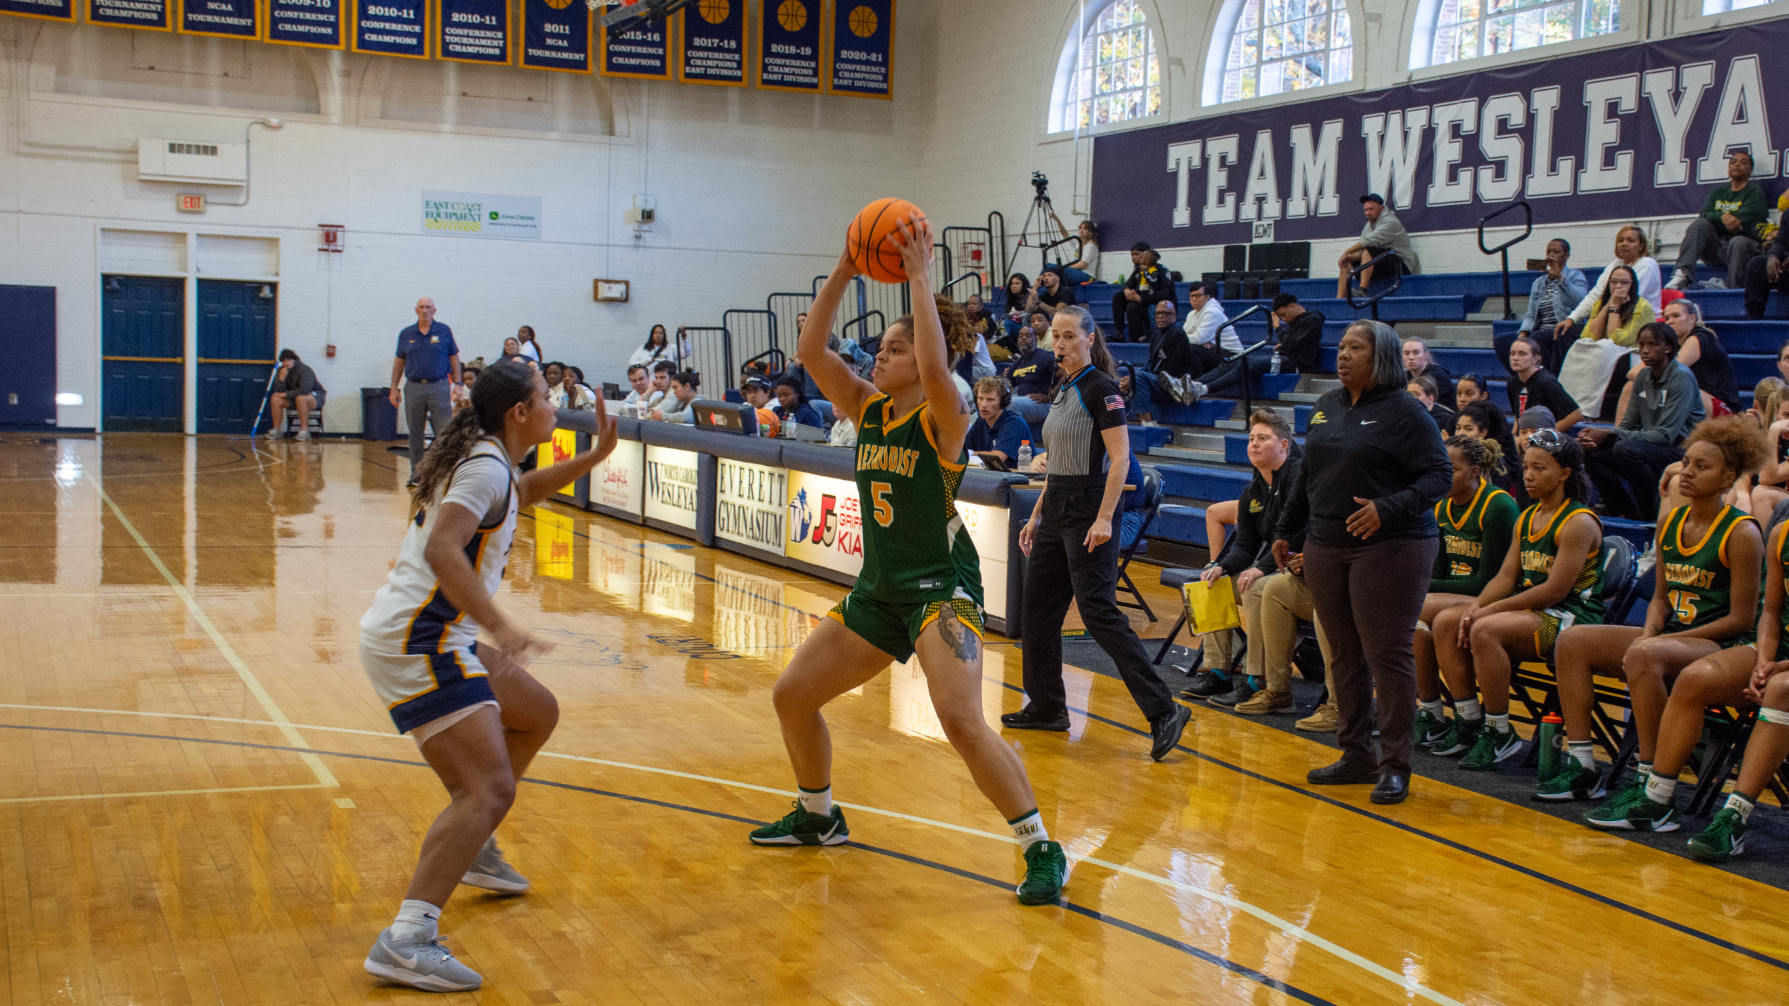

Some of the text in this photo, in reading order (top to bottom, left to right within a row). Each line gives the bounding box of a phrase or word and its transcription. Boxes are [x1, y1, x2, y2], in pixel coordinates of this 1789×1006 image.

[95, 0, 163, 11] TOURNAMENT
[207, 2, 233, 11] NCAA
[99, 7, 158, 20] CHAMPIONS
[274, 10, 336, 22] CONFERENCE
[367, 5, 415, 19] 2010-11
[187, 13, 253, 27] TOURNAMENT
[452, 12, 497, 25] 2010-11
[278, 23, 333, 35] CHAMPIONS
[361, 20, 421, 33] CONFERENCE
[544, 23, 570, 35] 2011
[364, 33, 418, 45] CHAMPIONS
[445, 27, 503, 39] CONFERENCE
[617, 31, 661, 42] 015-16
[444, 35, 504, 47] TOURNAMENT
[546, 38, 568, 47] NCAA
[693, 37, 737, 49] 2017-18
[449, 44, 500, 55] CHAMPIONS
[527, 48, 585, 61] TOURNAMENT
[609, 44, 664, 55] CONFERENCE
[687, 50, 740, 61] CONFERENCE
[771, 44, 812, 56] 2018-19
[612, 57, 661, 67] CHAMPIONS
[764, 57, 816, 68] CONFERENCE
[840, 50, 883, 63] 2020-21
[690, 58, 737, 69] CHAMPIONS
[835, 62, 886, 74] CONFERENCE
[685, 66, 742, 77] EAST DIVISION
[767, 65, 813, 76] CHAMPIONS
[838, 71, 883, 82] CHAMPIONS
[762, 73, 818, 84] EAST DIVISION
[833, 77, 888, 90] EAST DIVISION
[1167, 53, 1789, 228] TEAM WESLEYA
[184, 195, 201, 209] EXIT
[425, 200, 482, 212] EAST COAST
[425, 210, 482, 223] EQUIPMENT
[648, 460, 698, 512] WESLEYA
[720, 462, 785, 508] EVERETT
[871, 481, 894, 529] 5
[718, 499, 783, 548] GYMNASIUM
[837, 529, 863, 559] KIA
[1667, 590, 1701, 625] 15
